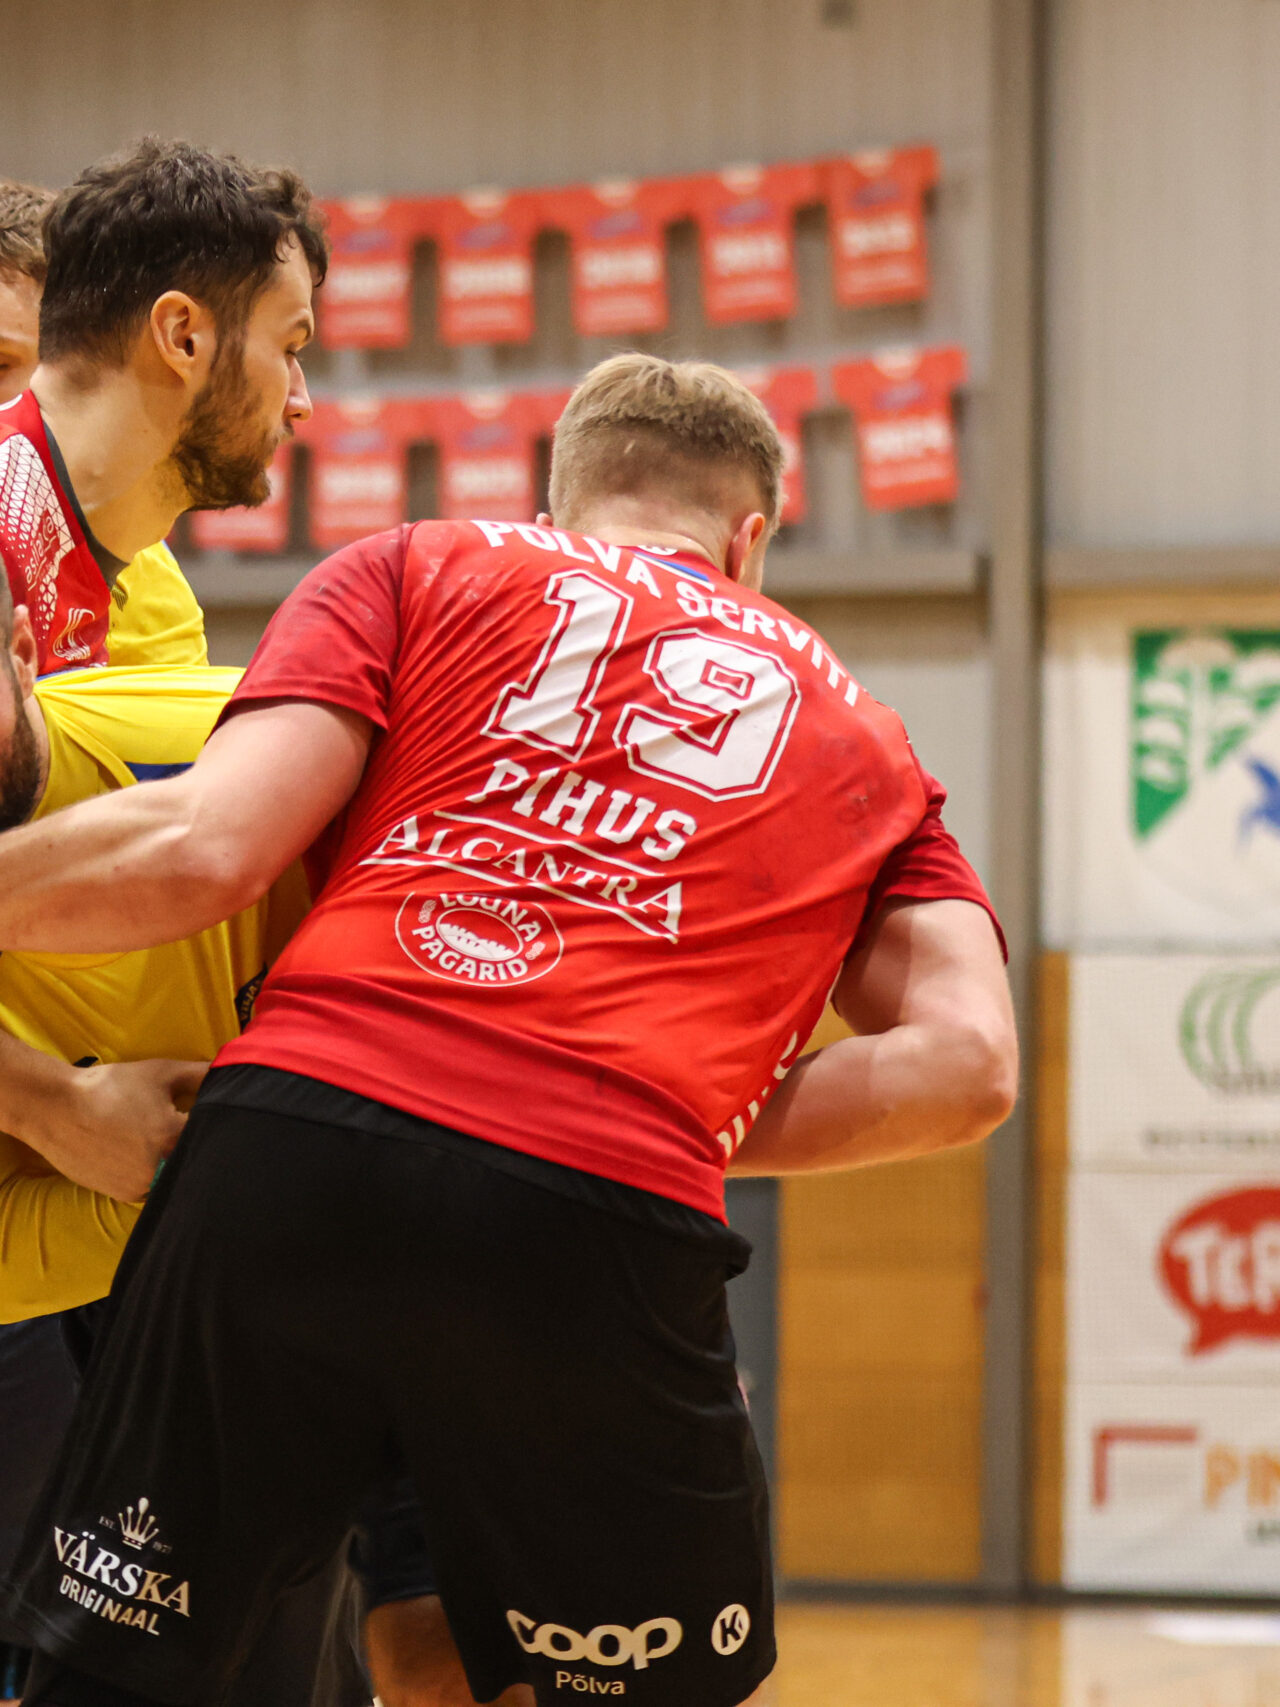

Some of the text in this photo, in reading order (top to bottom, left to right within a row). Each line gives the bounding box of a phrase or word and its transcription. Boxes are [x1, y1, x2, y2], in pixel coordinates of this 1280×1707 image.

[480, 568, 803, 803] 19
[675, 580, 859, 708] SERVITI
[465, 758, 697, 862] PIHUS
[370, 815, 683, 933] ALCANTRA
[411, 924, 529, 981] PAGARID
[54, 1525, 191, 1618] VÄRSKA
[59, 1574, 160, 1637] ORIGINAAL
[506, 1609, 682, 1670] coop
[556, 1670, 626, 1695] Põlva
